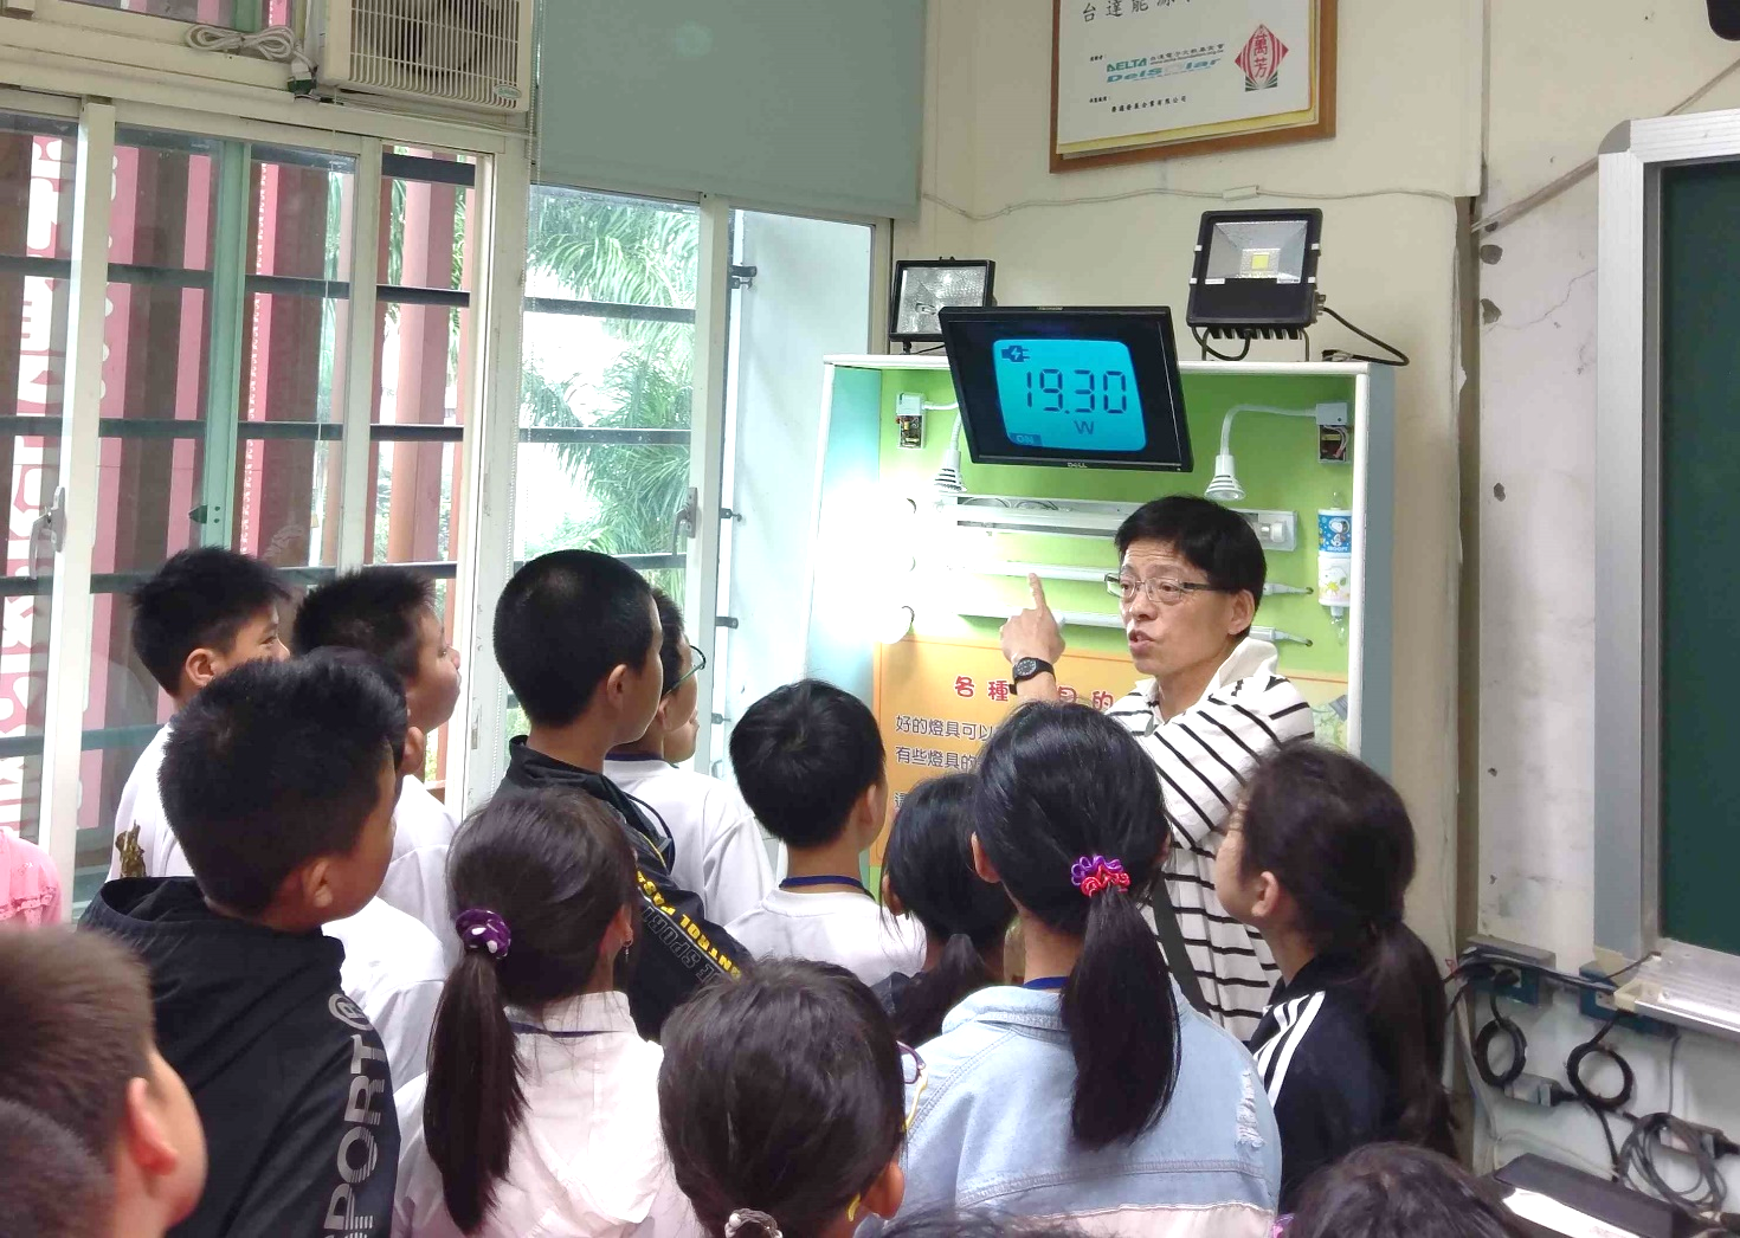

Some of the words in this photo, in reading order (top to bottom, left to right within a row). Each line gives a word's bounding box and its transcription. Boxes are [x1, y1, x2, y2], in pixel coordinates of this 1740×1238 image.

[1106, 57, 1147, 73] DELTA
[1253, 32, 1268, 78] 萬芳
[1027, 369, 1126, 414] 19.30
[1074, 421, 1094, 435] W
[323, 1034, 386, 1238] PORT
